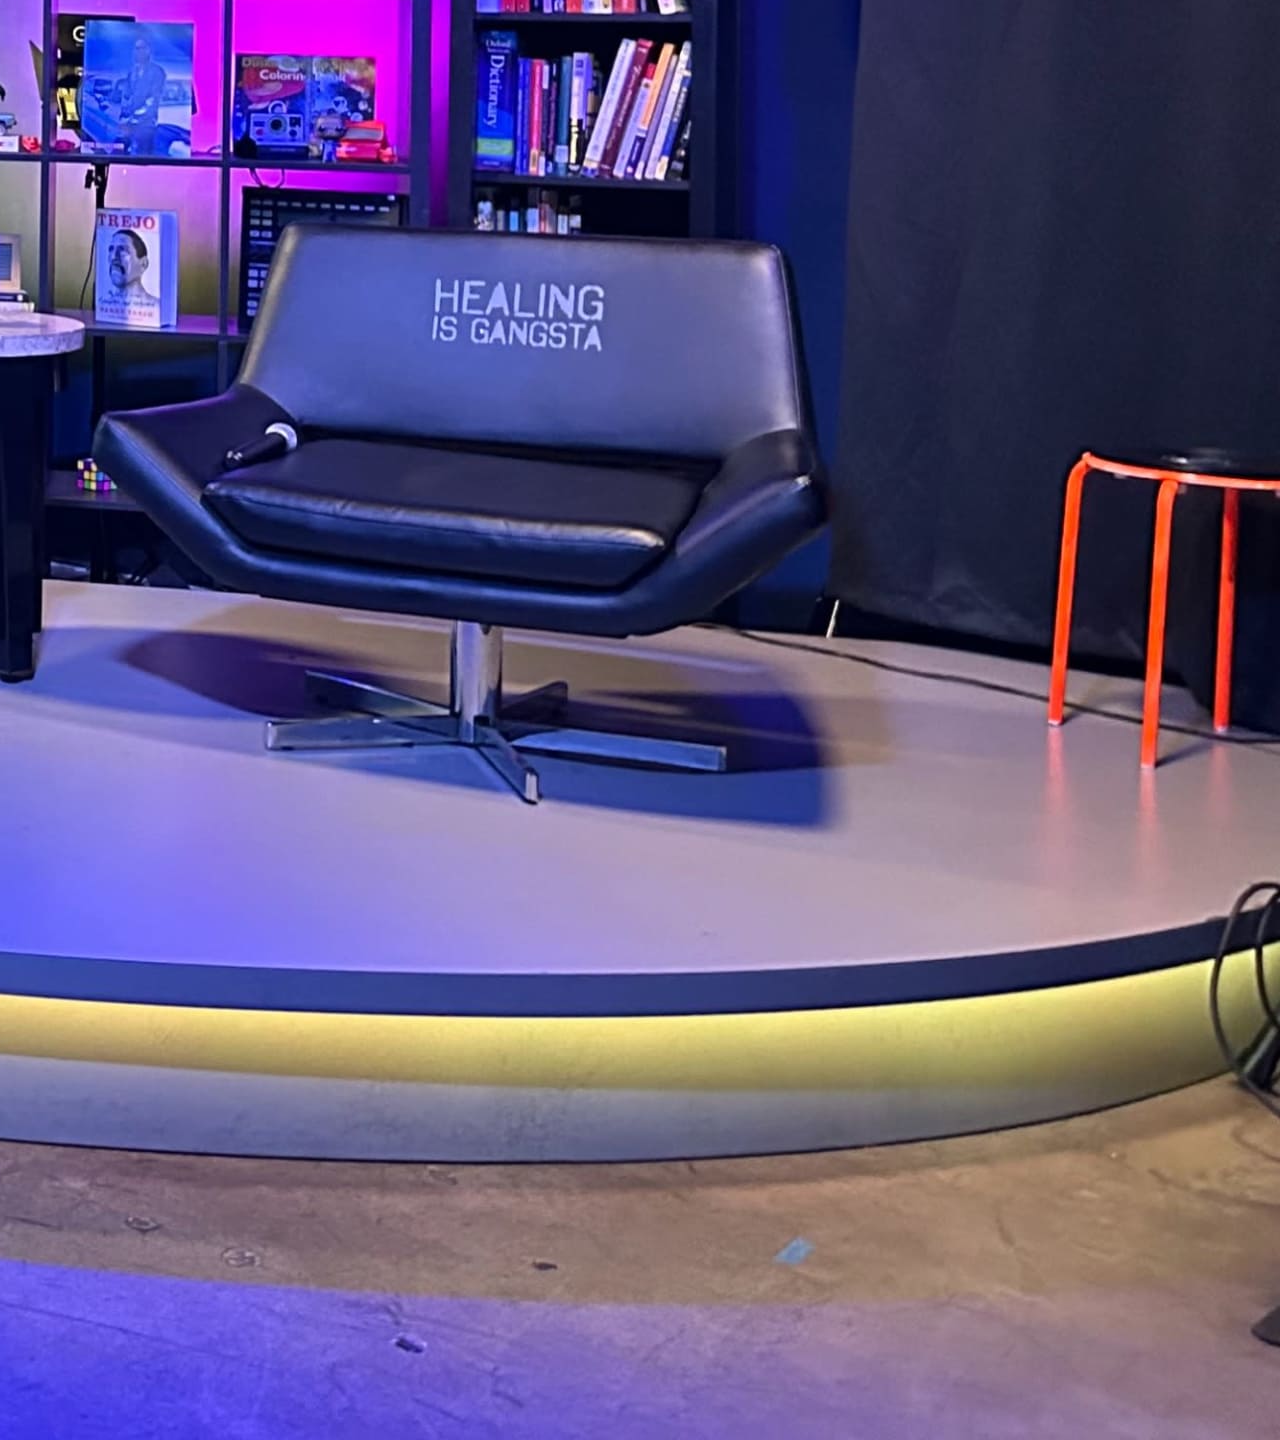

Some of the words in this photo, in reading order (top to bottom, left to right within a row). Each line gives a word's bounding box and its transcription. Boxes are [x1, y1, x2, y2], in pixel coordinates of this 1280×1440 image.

[483, 54, 506, 128] Dictionary
[97, 212, 156, 230] TREJO
[434, 277, 605, 321] HEALING
[432, 315, 458, 342] IS
[470, 317, 603, 352] GANGSTA
